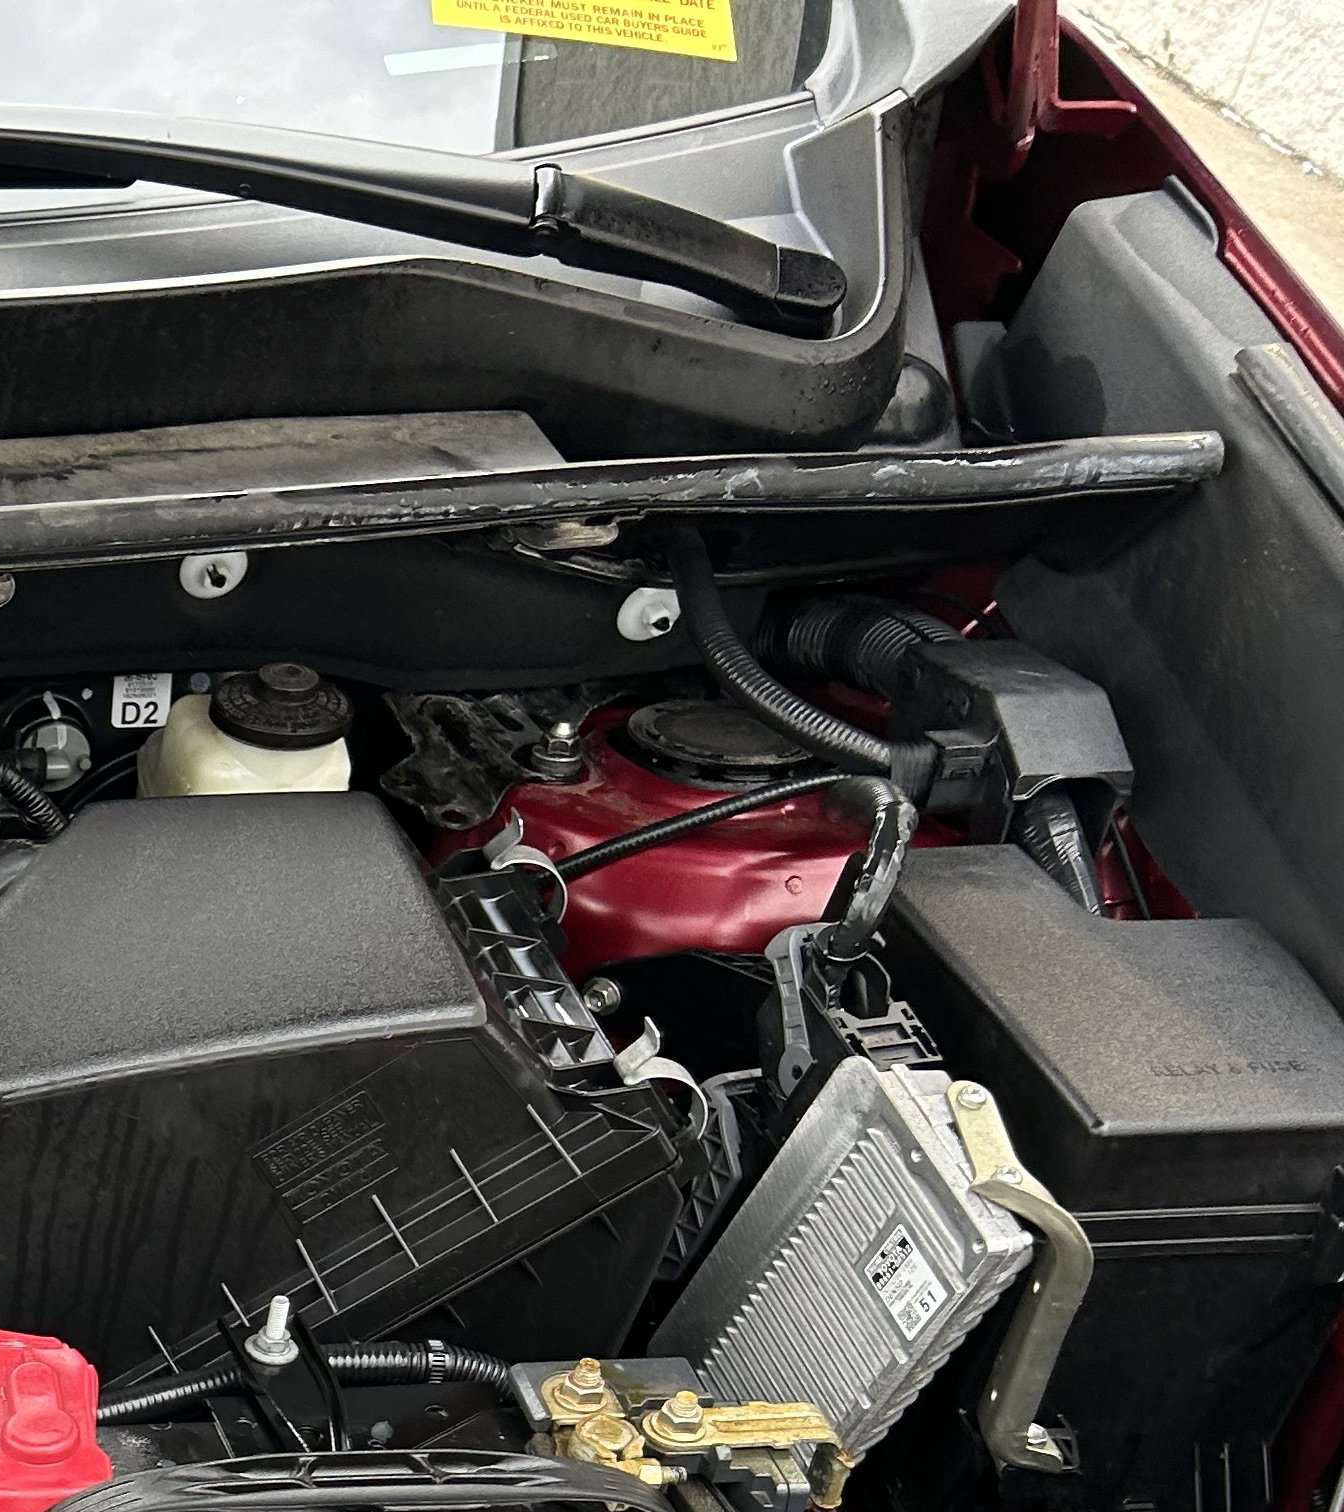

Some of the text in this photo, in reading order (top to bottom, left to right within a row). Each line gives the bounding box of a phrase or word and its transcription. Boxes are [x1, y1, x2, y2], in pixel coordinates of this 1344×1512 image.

[456, 0, 708, 38] UNTIL A FEDERAL USED CAR BUYERS GUIDE
[499, 14, 512, 24] IS
[515, 16, 565, 30] AFFIXED
[568, 22, 583, 33] TO
[586, 24, 613, 35] THIS
[551, 1, 587, 12] MUST
[593, 5, 643, 19] REMAIN
[648, 12, 660, 22] IN
[665, 14, 705, 28] PLACE
[120, 701, 159, 725] D2
[877, 1242, 904, 1277] TOYOTA
[918, 1288, 937, 1313] 51
